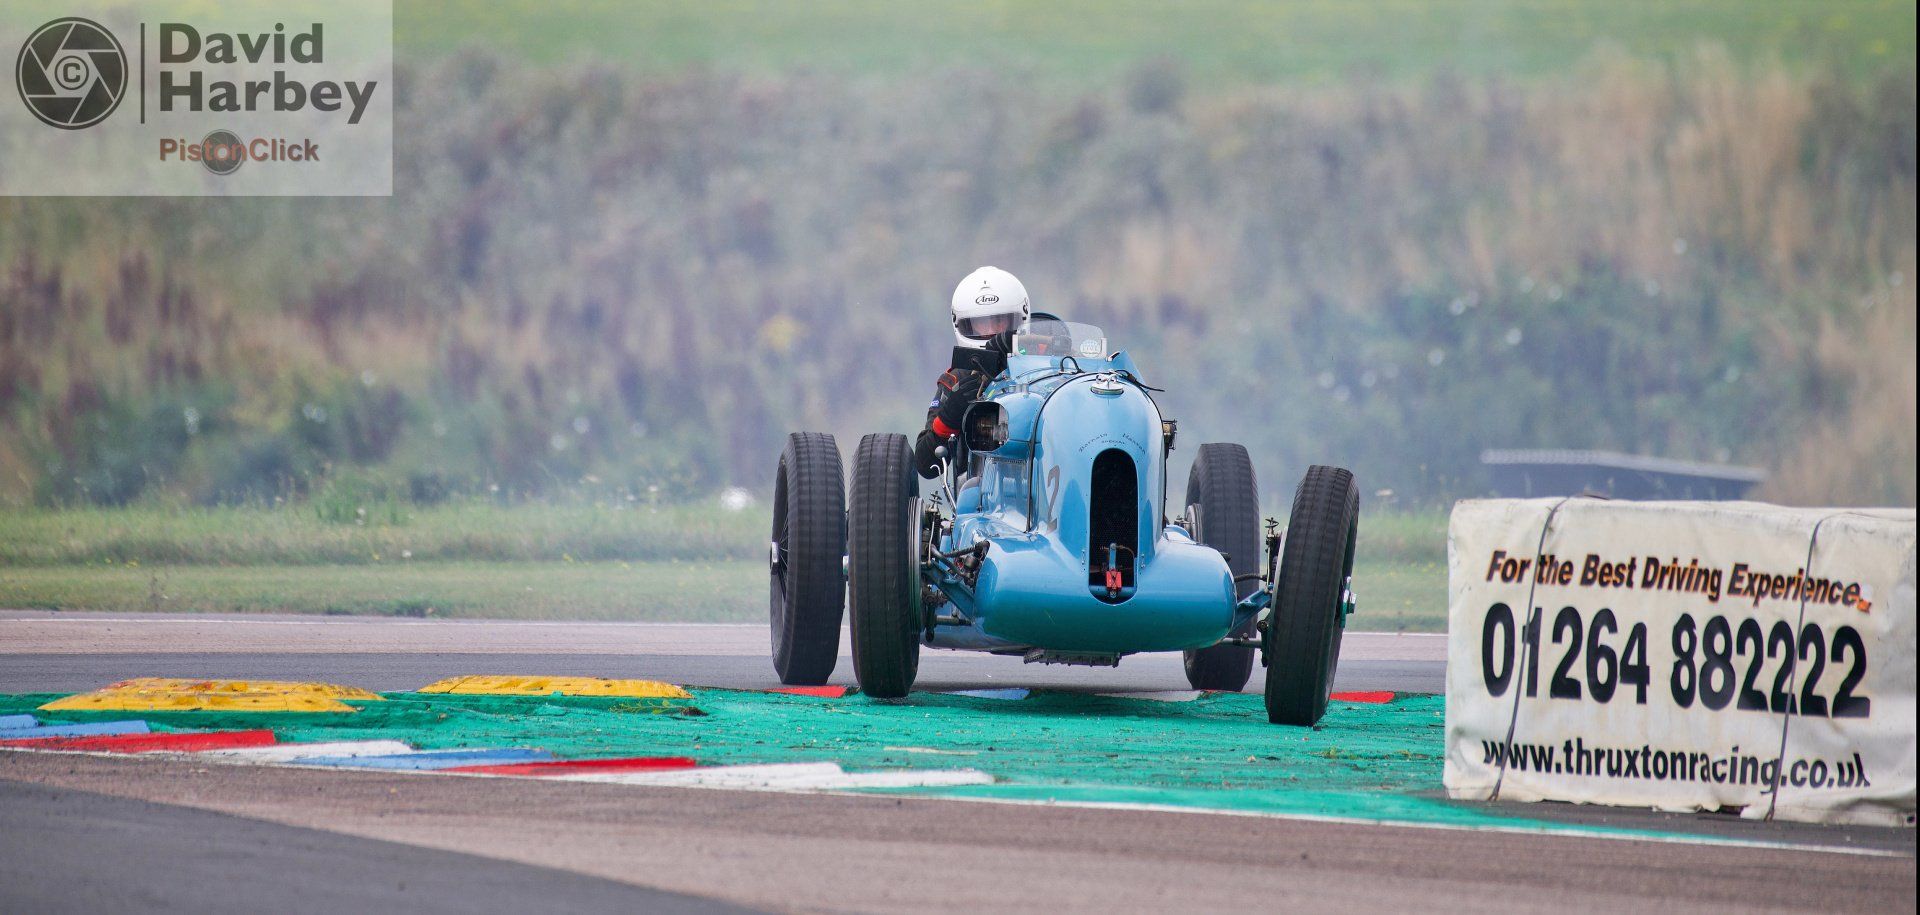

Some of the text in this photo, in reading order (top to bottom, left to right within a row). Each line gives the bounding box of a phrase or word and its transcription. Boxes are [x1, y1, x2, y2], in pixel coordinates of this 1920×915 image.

[1486, 550, 1532, 583] For
[1537, 554, 1574, 585] the
[1580, 554, 1637, 589] Best
[1641, 556, 1723, 602] Driving
[1482, 602, 1871, 719] 01264 882222
[1482, 737, 1871, 794] www.thruxtonracing.co.uk
